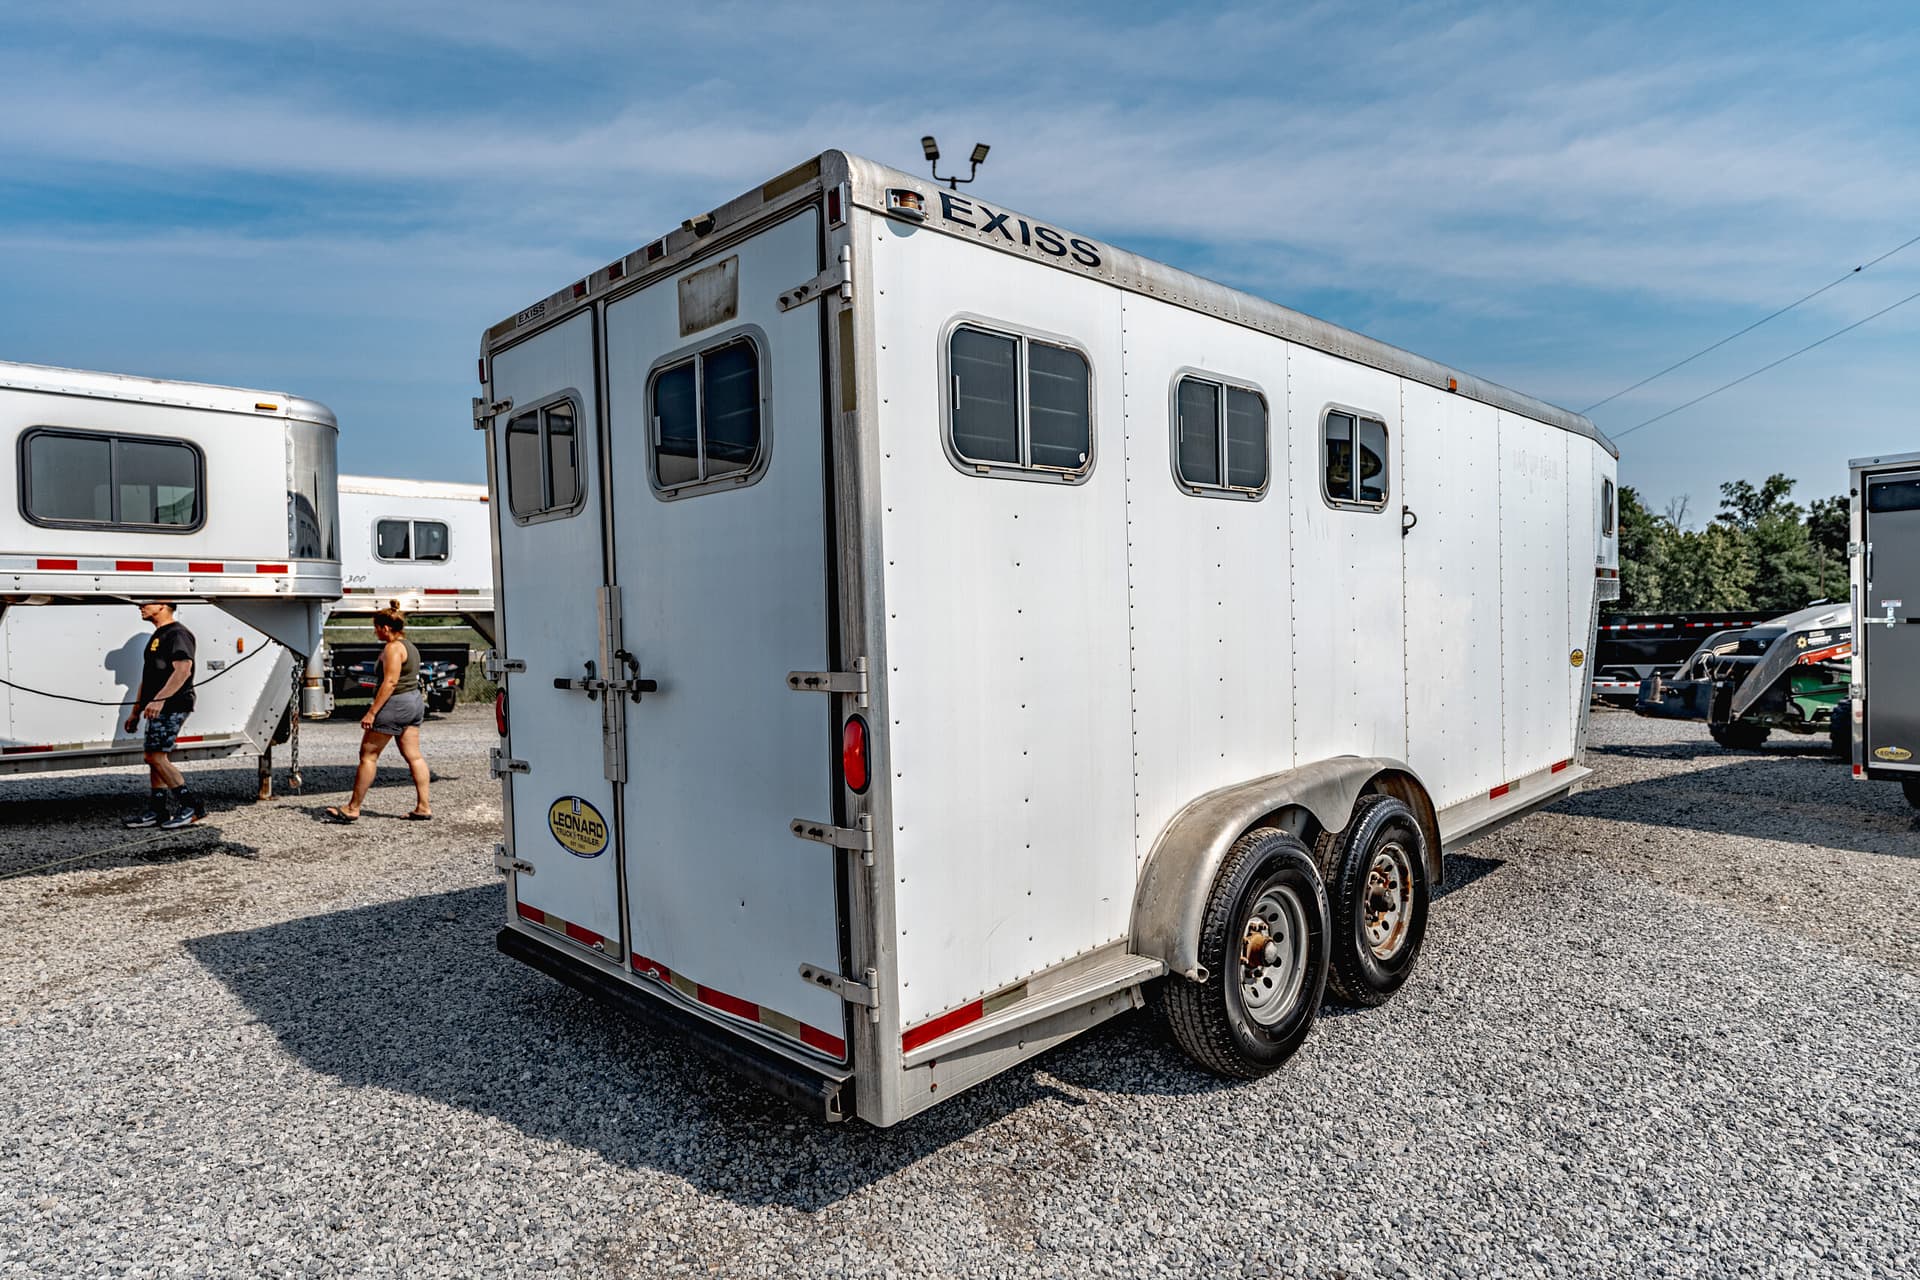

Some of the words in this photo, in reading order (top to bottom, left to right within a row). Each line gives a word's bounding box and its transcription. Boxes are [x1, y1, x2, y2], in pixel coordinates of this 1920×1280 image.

[938, 191, 1102, 268] EXISS
[519, 303, 545, 323] EXISS
[552, 810, 603, 839] LEONARD
